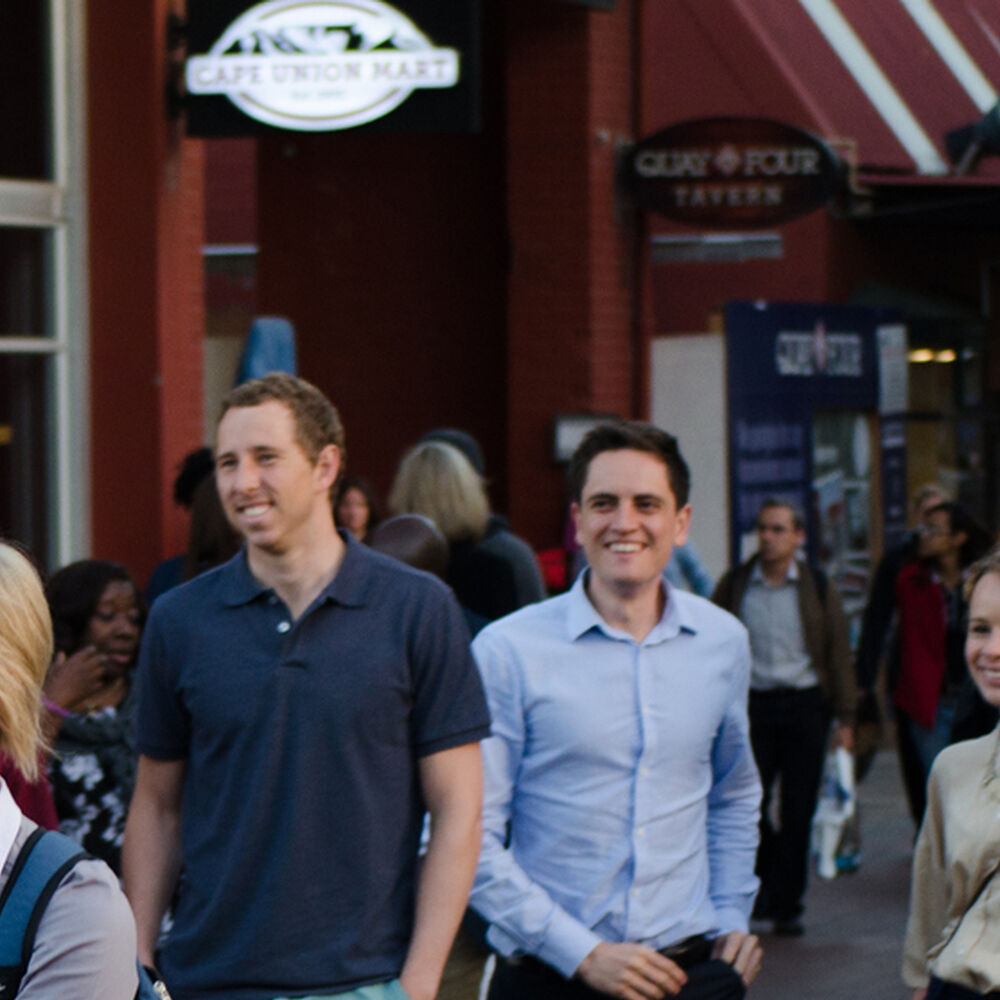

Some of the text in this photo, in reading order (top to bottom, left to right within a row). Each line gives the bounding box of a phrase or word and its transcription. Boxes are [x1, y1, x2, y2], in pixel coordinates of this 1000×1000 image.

[195, 58, 449, 86] CAPE UNION MART
[634, 149, 820, 178] QUAY FOUR
[674, 185, 783, 207] TAVERN
